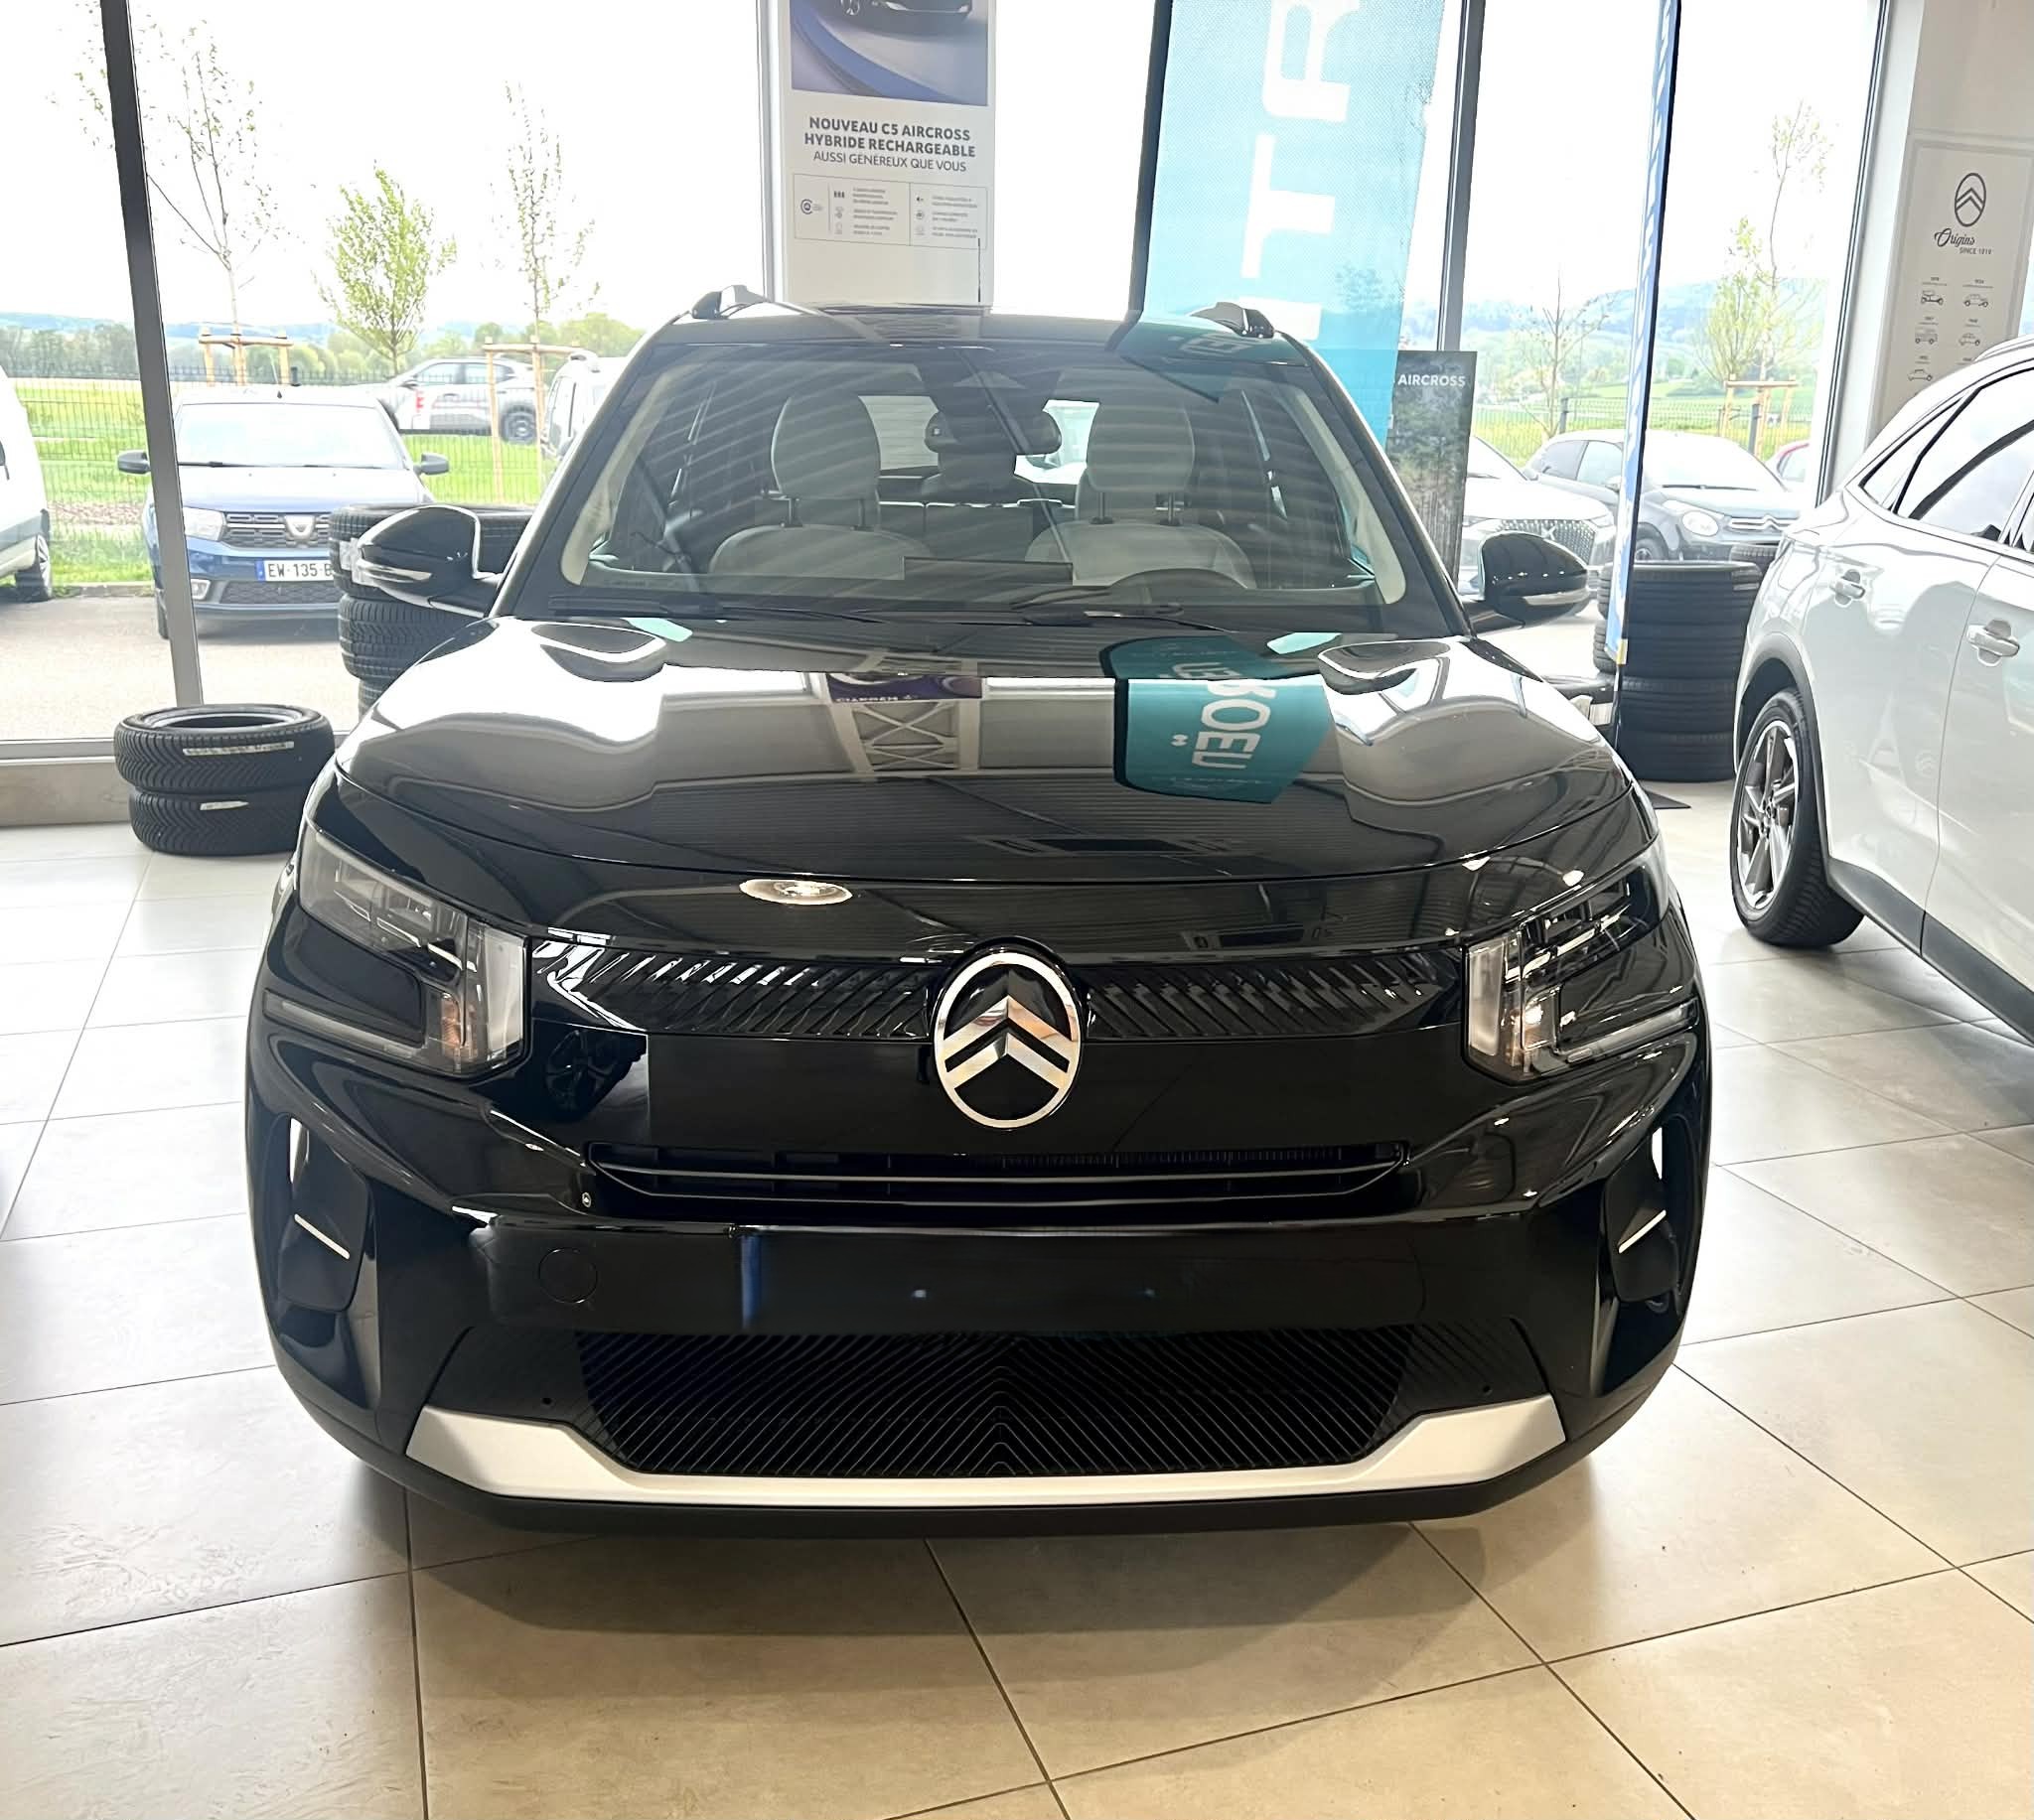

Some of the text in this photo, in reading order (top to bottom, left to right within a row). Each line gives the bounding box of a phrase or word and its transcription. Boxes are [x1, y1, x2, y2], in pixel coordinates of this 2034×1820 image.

[809, 116, 970, 141] NOUVEAU C5 AIRCROSS
[804, 132, 976, 157] HYBRIDE RECHARGEABLE
[813, 151, 846, 163] AUSSI
[911, 158, 935, 170] QUE
[936, 160, 966, 172] VOUS
[1934, 227, 1975, 247] Origins
[1397, 374, 1466, 388] AIRCROSS
